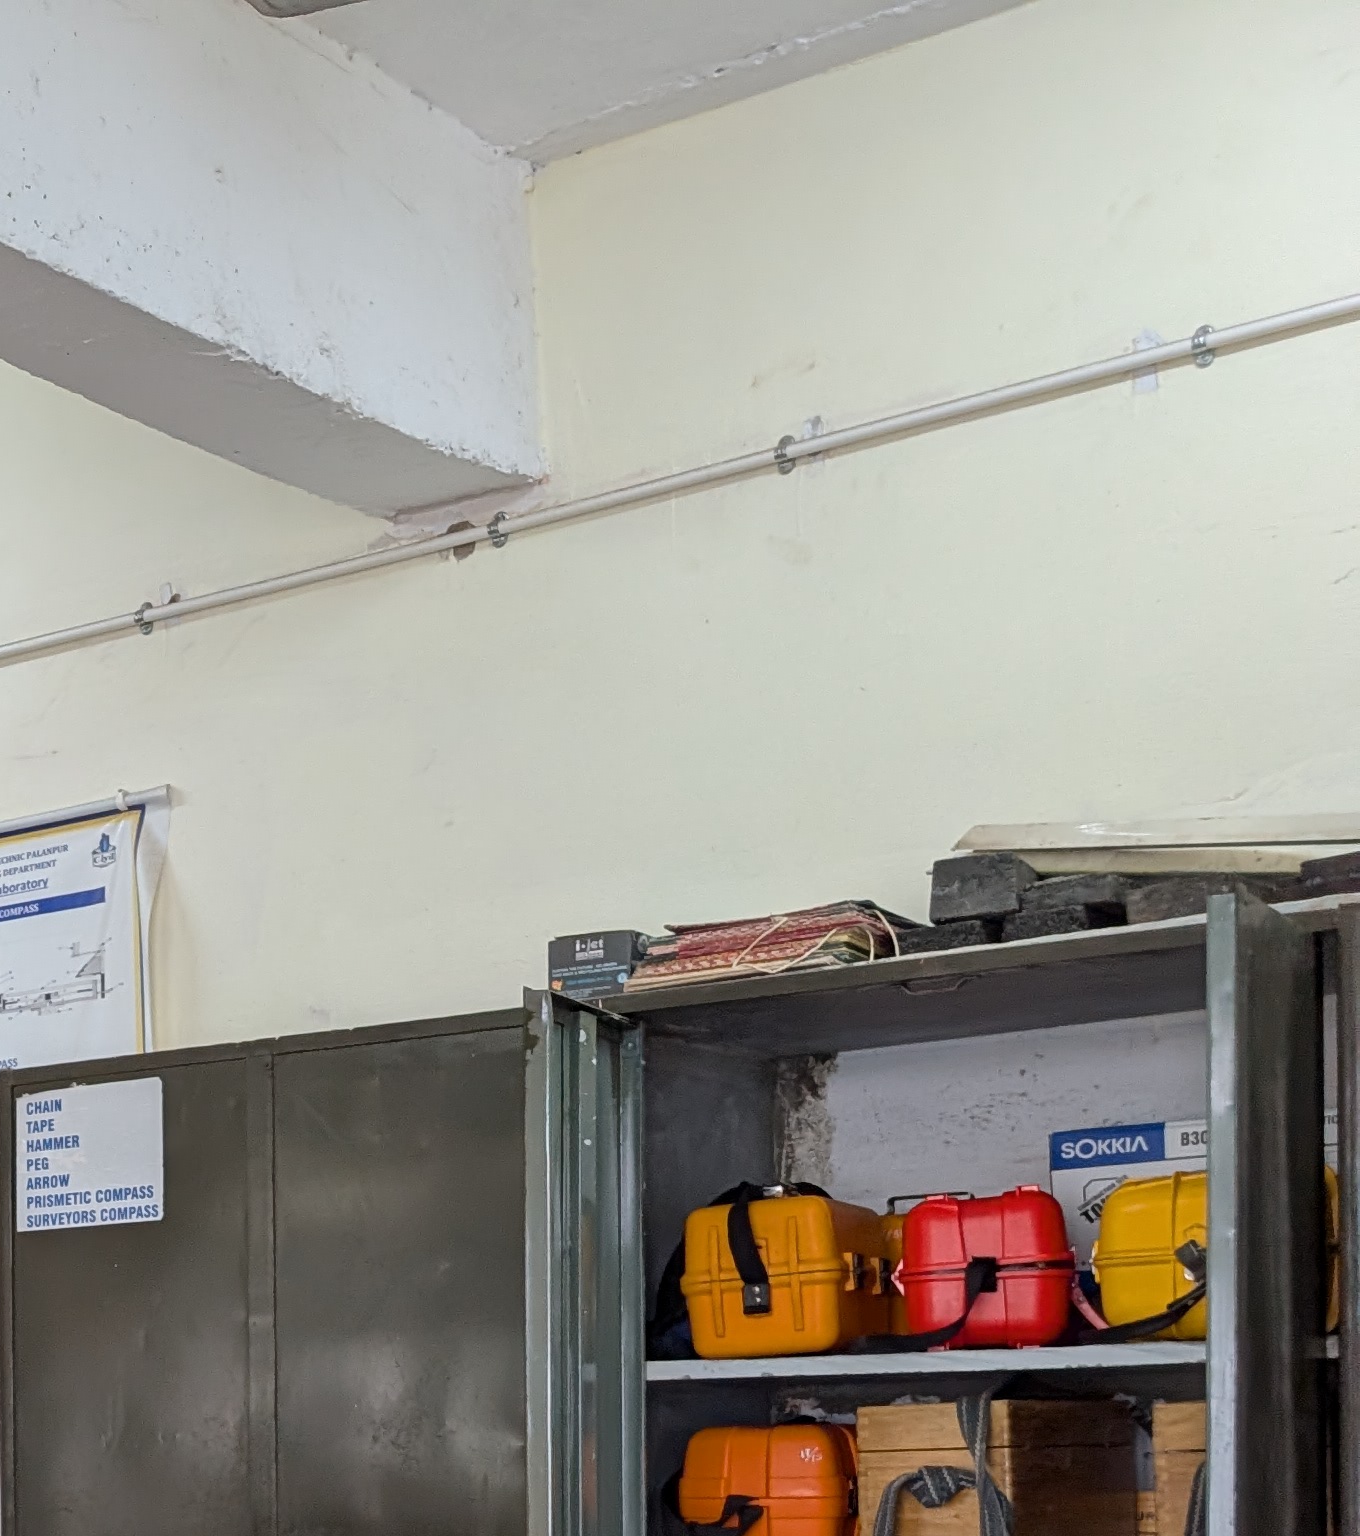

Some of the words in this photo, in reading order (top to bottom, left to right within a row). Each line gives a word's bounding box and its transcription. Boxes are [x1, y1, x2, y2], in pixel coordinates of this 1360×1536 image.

[26, 844, 69, 860] PALANPUR
[2, 860, 57, 879] DEPARTMENT
[26, 1099, 62, 1115] CHAIN
[26, 1119, 55, 1134] TAPE
[26, 1135, 80, 1153] HAMMER
[1061, 1136, 1148, 1159] SOKKIA
[26, 1157, 49, 1172] PEG
[26, 1174, 70, 1190] ARROW
[27, 1191, 91, 1209] PRISMETIC
[95, 1185, 154, 1203] COMPASS
[27, 1210, 96, 1228] SURVEYORS
[100, 1204, 159, 1222] COMPASS
